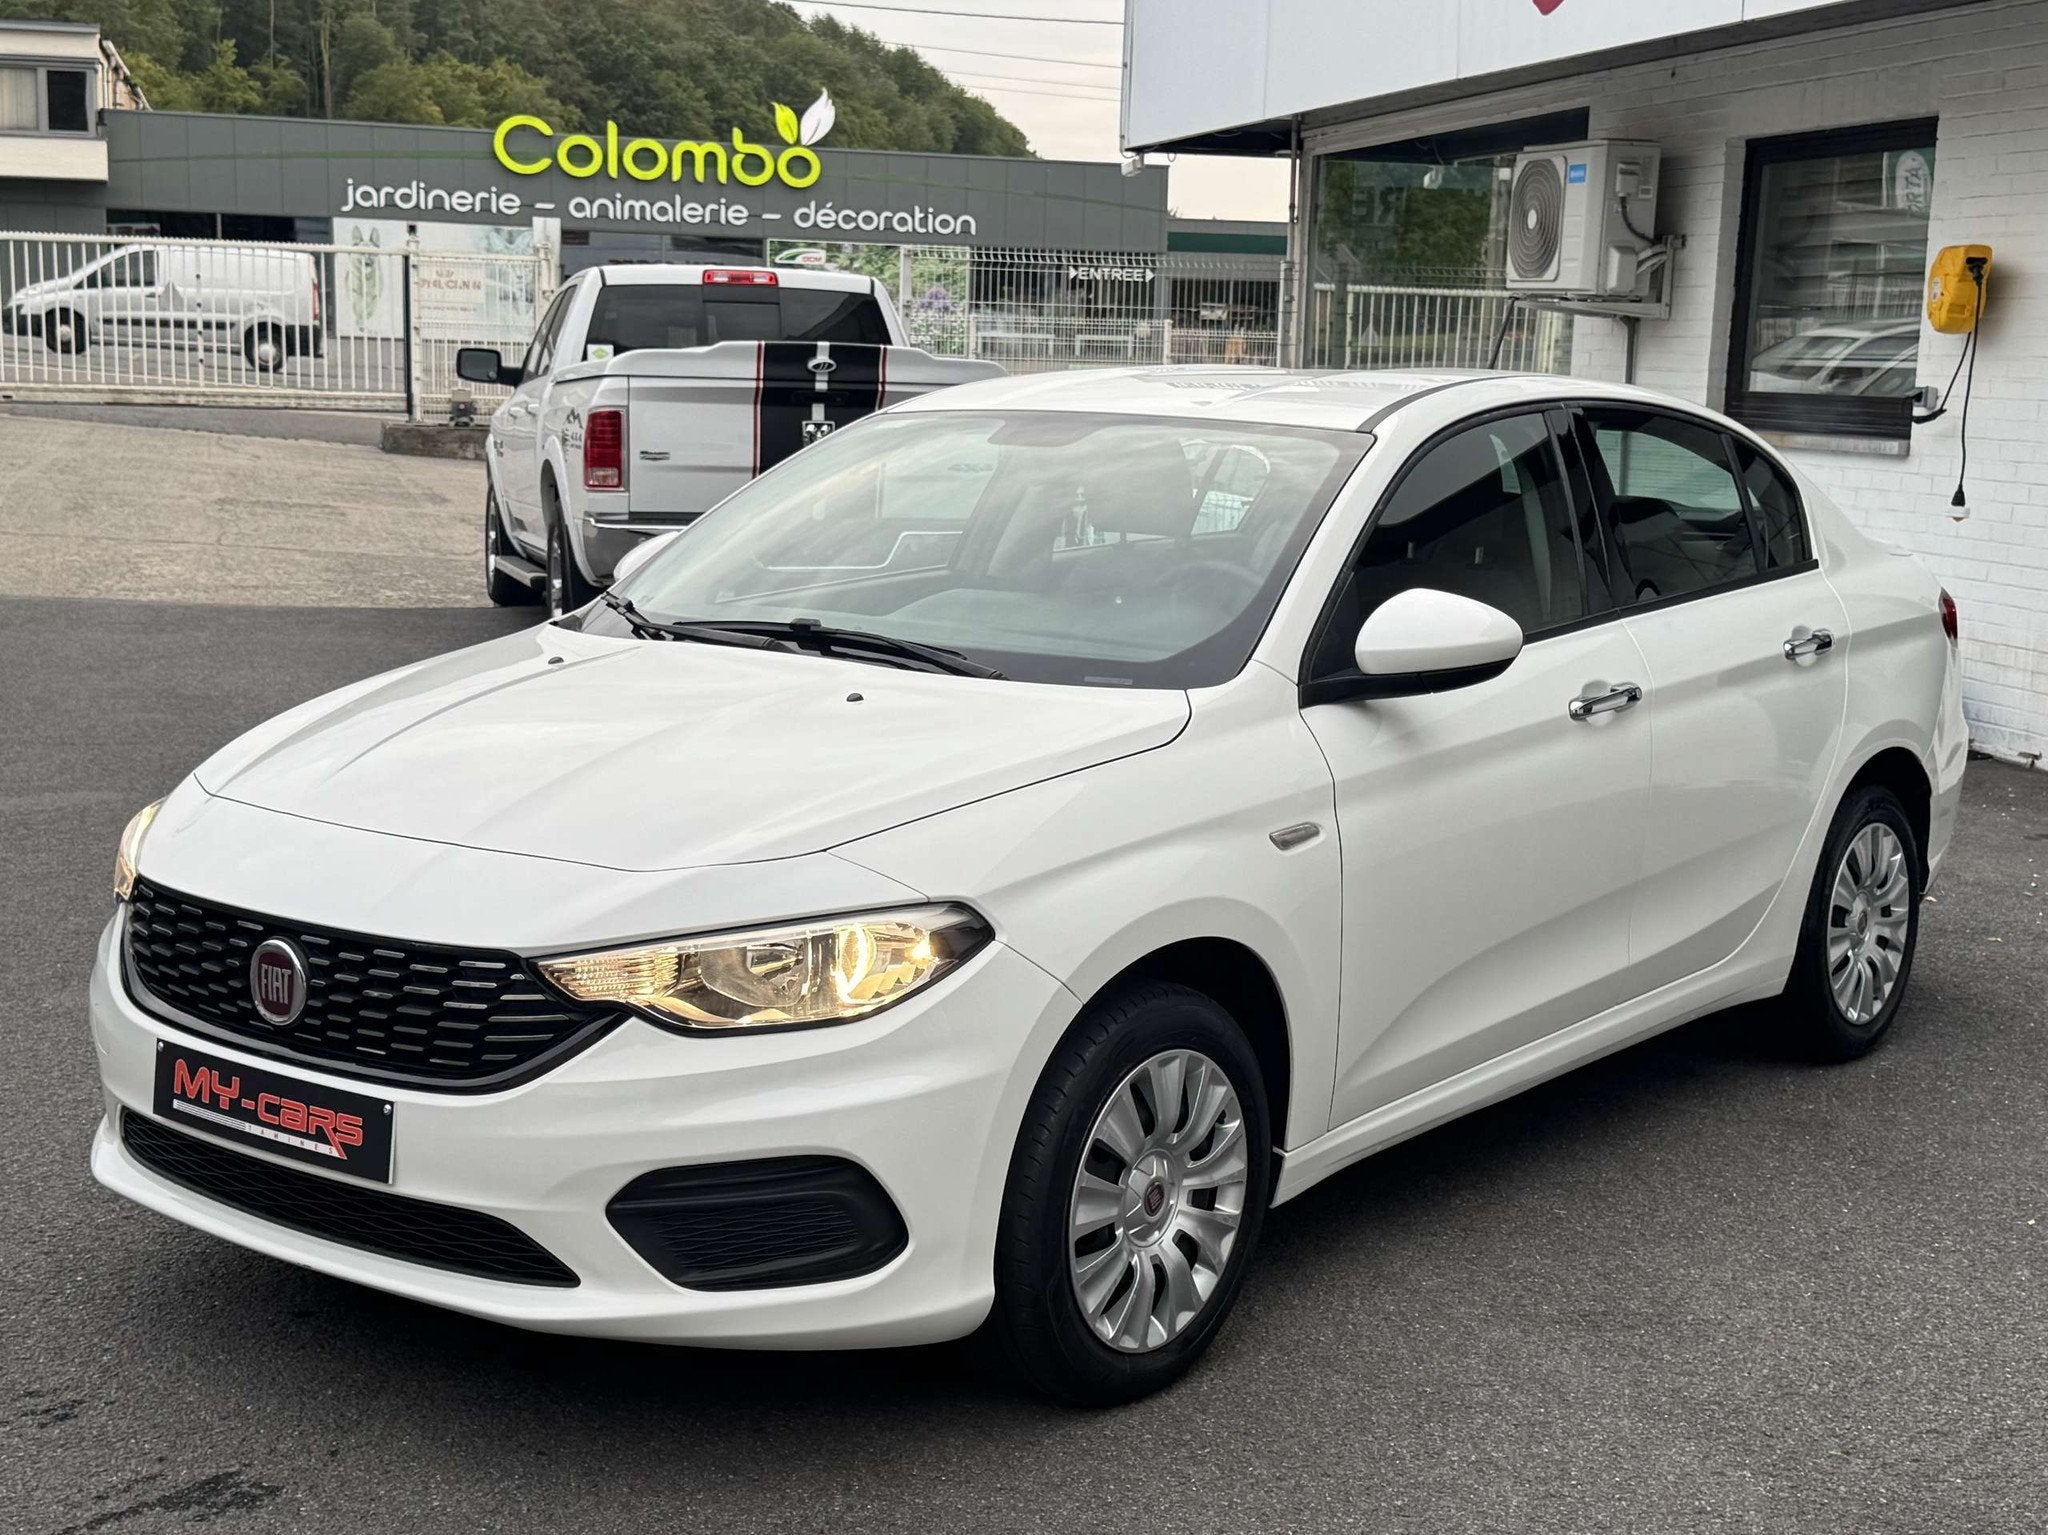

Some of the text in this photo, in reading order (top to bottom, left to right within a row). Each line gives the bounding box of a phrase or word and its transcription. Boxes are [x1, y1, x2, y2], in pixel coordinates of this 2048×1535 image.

[493, 115, 821, 188] Colombo
[340, 178, 521, 215] jardinerie
[568, 193, 749, 226] animalerie
[793, 200, 977, 236] décoration
[1078, 266, 1144, 281] ENTREE
[261, 963, 292, 1005] FIAT
